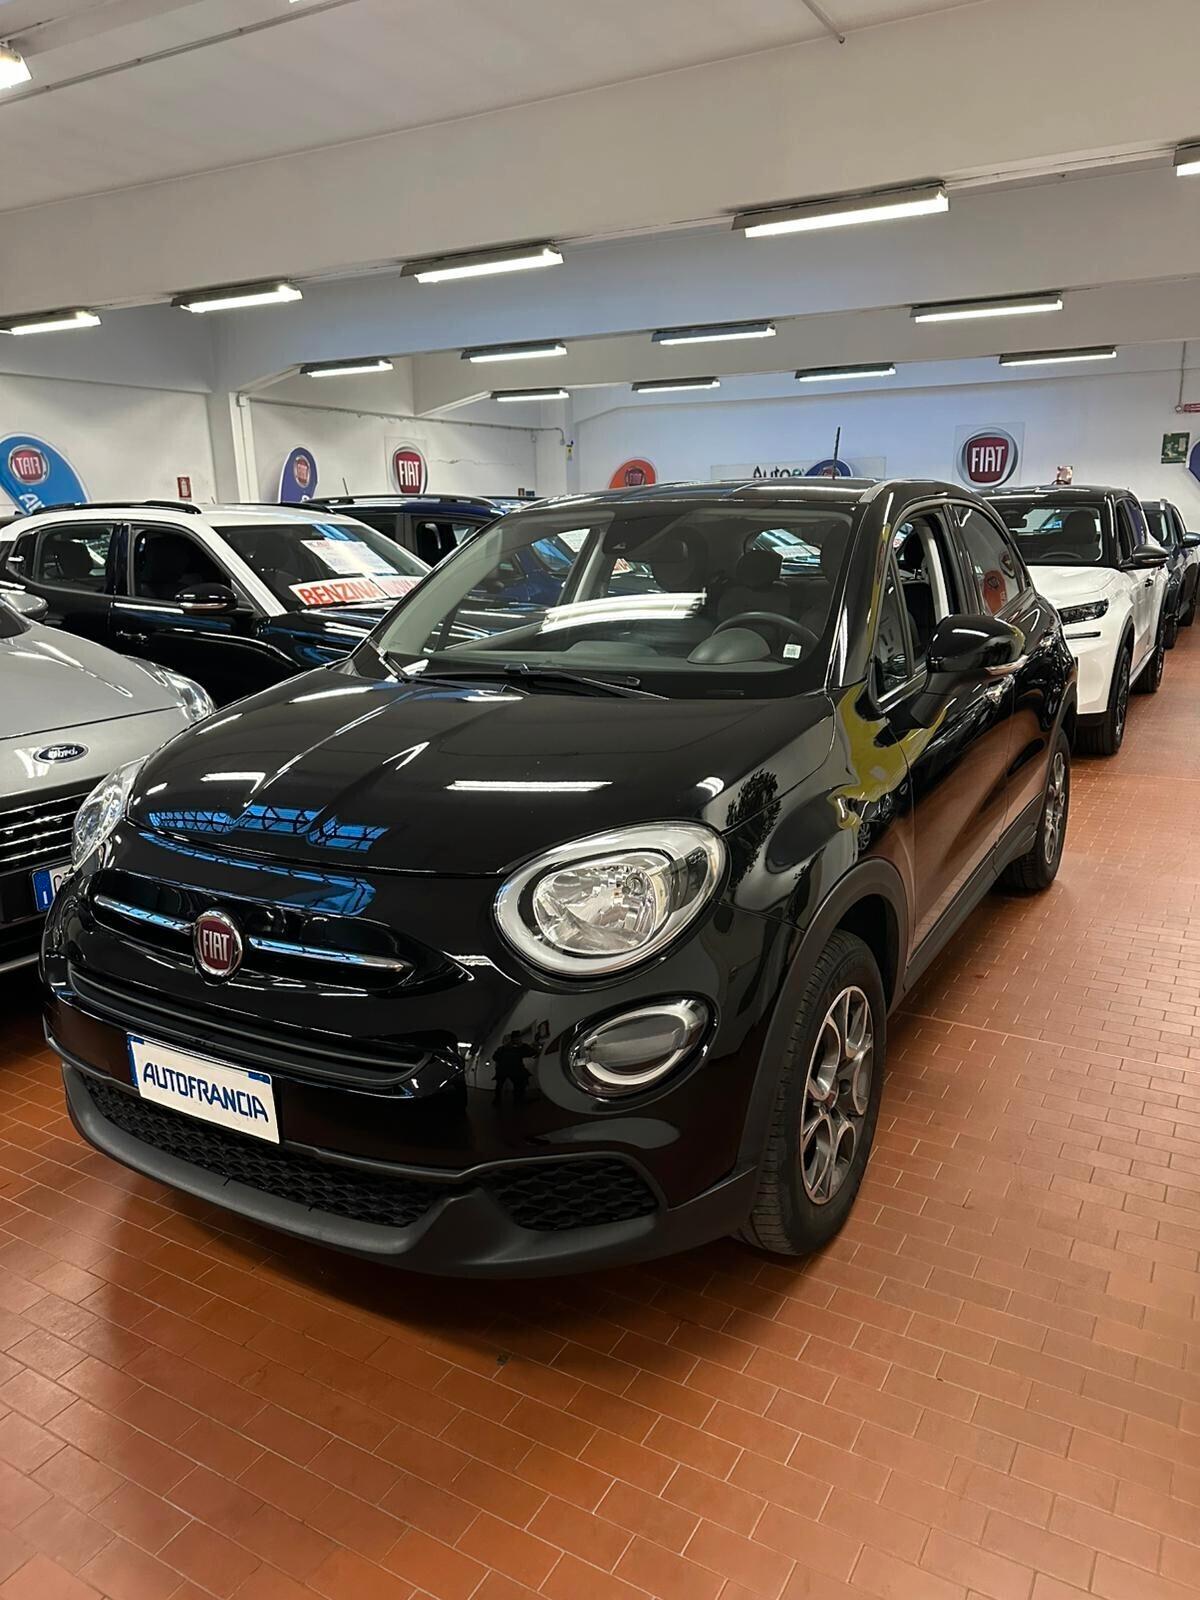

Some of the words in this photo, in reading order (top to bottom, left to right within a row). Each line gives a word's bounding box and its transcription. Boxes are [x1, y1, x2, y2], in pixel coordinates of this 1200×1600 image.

[971, 445, 1005, 472] FIAT
[398, 460, 419, 486] FIAT
[298, 577, 383, 605] BENZINA
[202, 929, 230, 962] FIAT
[143, 1062, 269, 1123] AUTOFRANCIA
